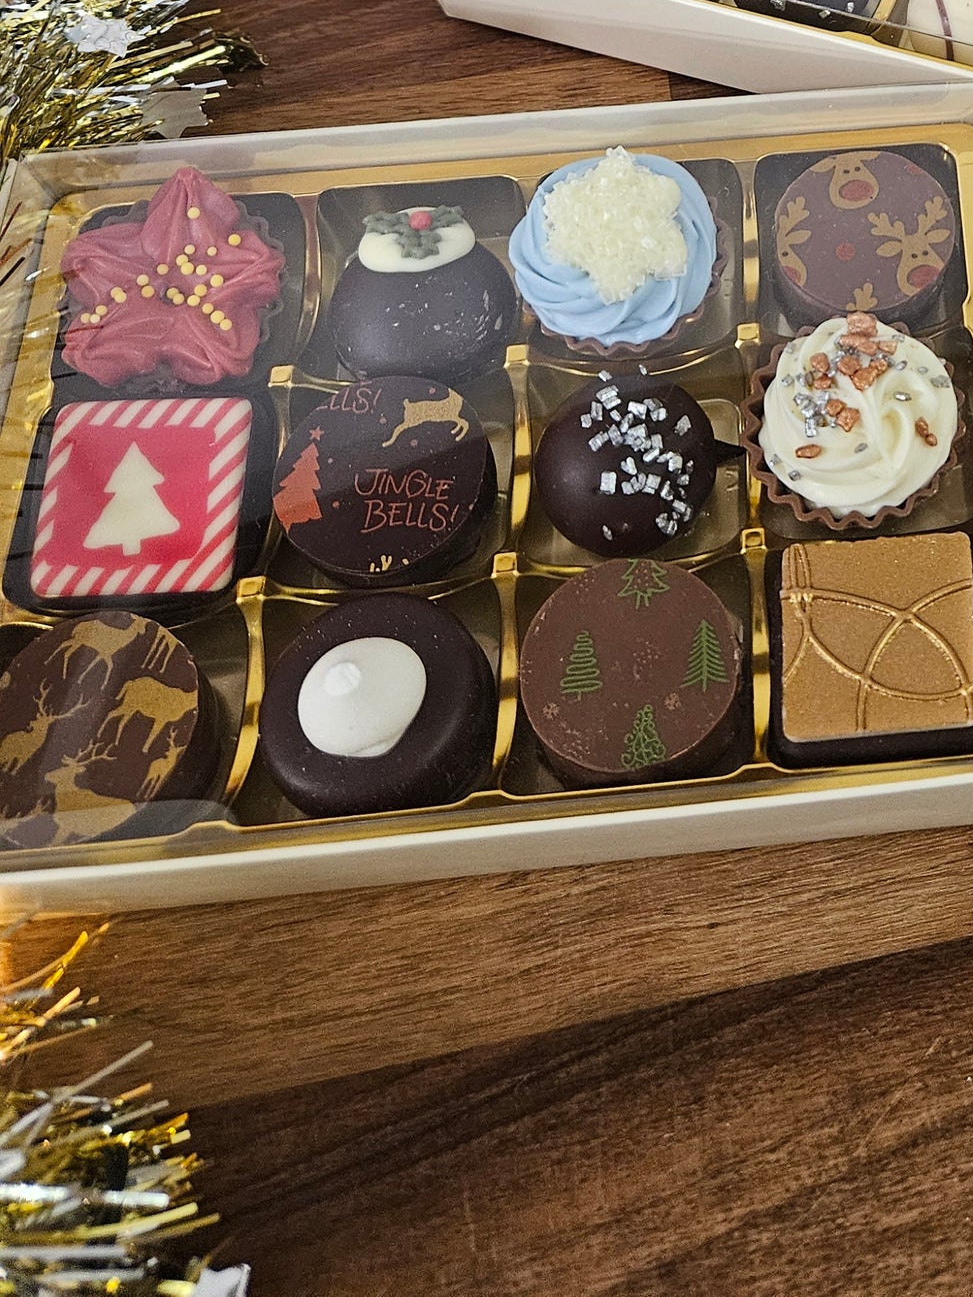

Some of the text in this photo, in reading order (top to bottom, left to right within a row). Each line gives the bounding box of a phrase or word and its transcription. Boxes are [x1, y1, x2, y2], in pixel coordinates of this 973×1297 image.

[316, 387, 382, 414] LLS!
[354, 468, 454, 500] JINGLE
[360, 500, 459, 534] BELLS!
